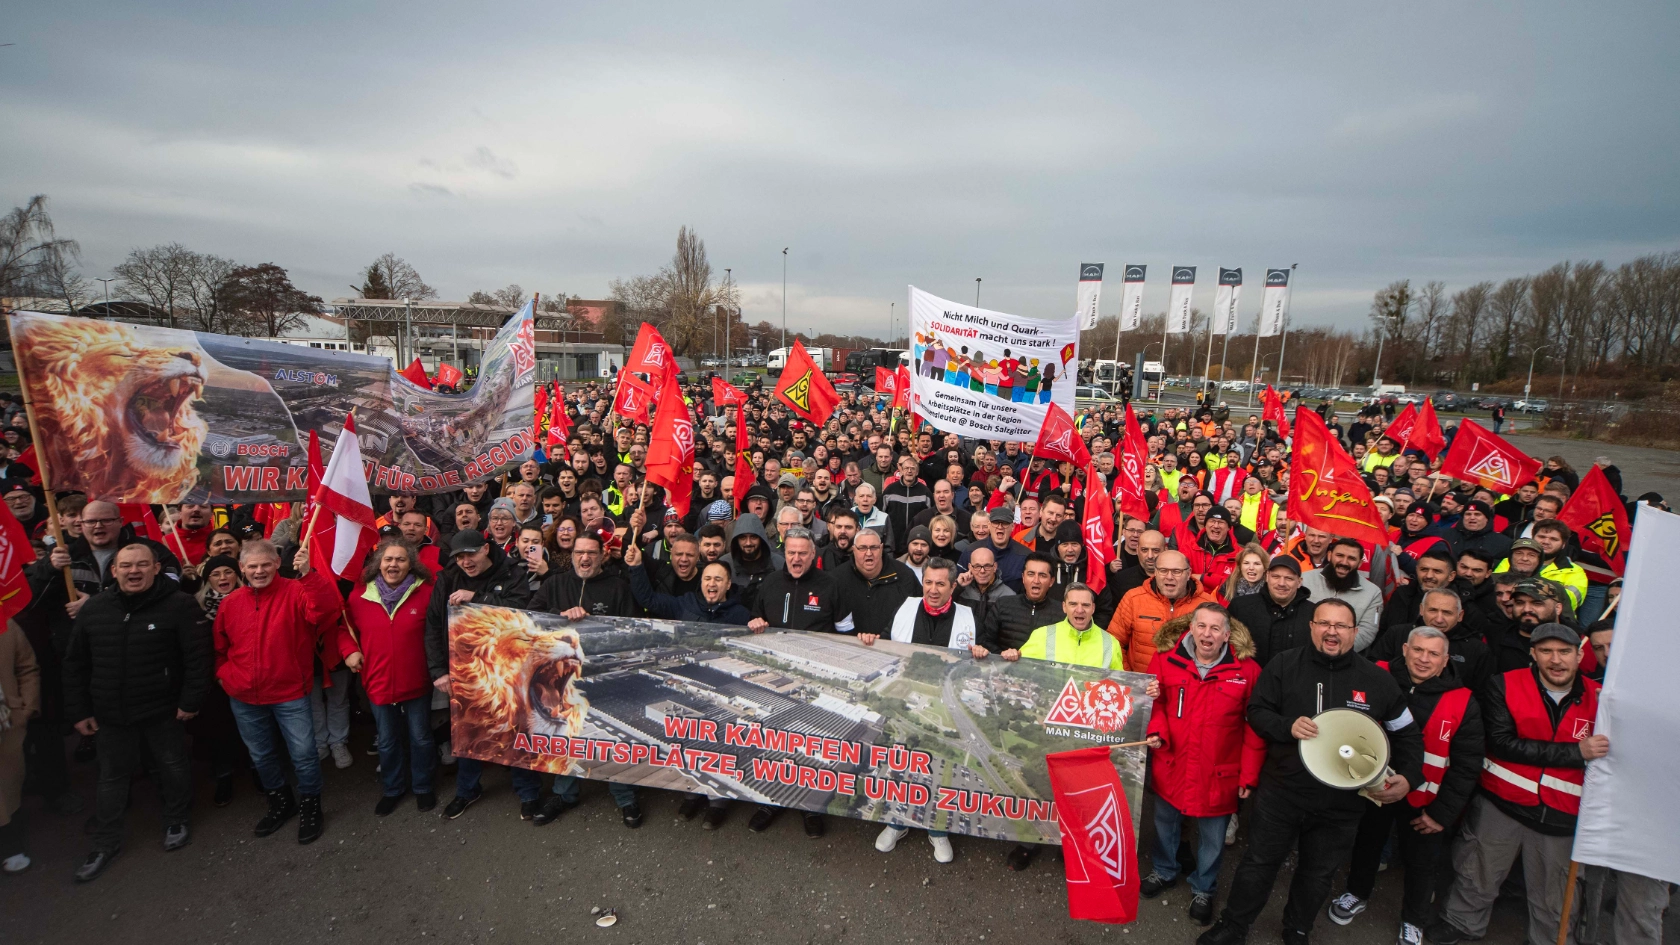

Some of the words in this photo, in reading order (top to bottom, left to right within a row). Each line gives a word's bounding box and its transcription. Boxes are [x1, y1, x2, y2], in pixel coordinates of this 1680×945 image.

[930, 320, 978, 338] SOLIDARITÄT
[979, 332, 1009, 344] macht
[1010, 338, 1027, 346] uns
[1028, 338, 1051, 347] stark
[942, 310, 964, 322] Nicht
[964, 314, 989, 326] Milch
[990, 320, 1009, 331] und
[1011, 324, 1039, 336] Quark
[275, 368, 337, 385] ALSTOM
[515, 374, 533, 389] MAN
[928, 399, 971, 416] Arbeitsplätze
[972, 410, 980, 418] in
[981, 412, 996, 421] der
[996, 415, 1022, 424] Region
[934, 390, 977, 407] Gemeinsam
[978, 400, 990, 409] für
[991, 404, 1017, 413] unsere
[958, 417, 968, 426] @
[969, 419, 993, 431] Bosch
[994, 425, 1033, 436] Salzgitter
[237, 443, 289, 457] BOSCH
[375, 465, 416, 491] FÜR
[419, 469, 463, 491] DIE
[464, 426, 535, 481] REGION
[223, 465, 281, 491] WIR
[663, 715, 718, 743] WIR
[725, 720, 861, 765] KÄMPFEN
[869, 743, 932, 775] FÜR
[1045, 726, 1071, 737] MAN
[1074, 730, 1126, 743] Salzgitter
[513, 732, 745, 782] ARBEITSPLÄTZE,
[752, 757, 857, 796] WÜRDE
[864, 777, 930, 807] UND
